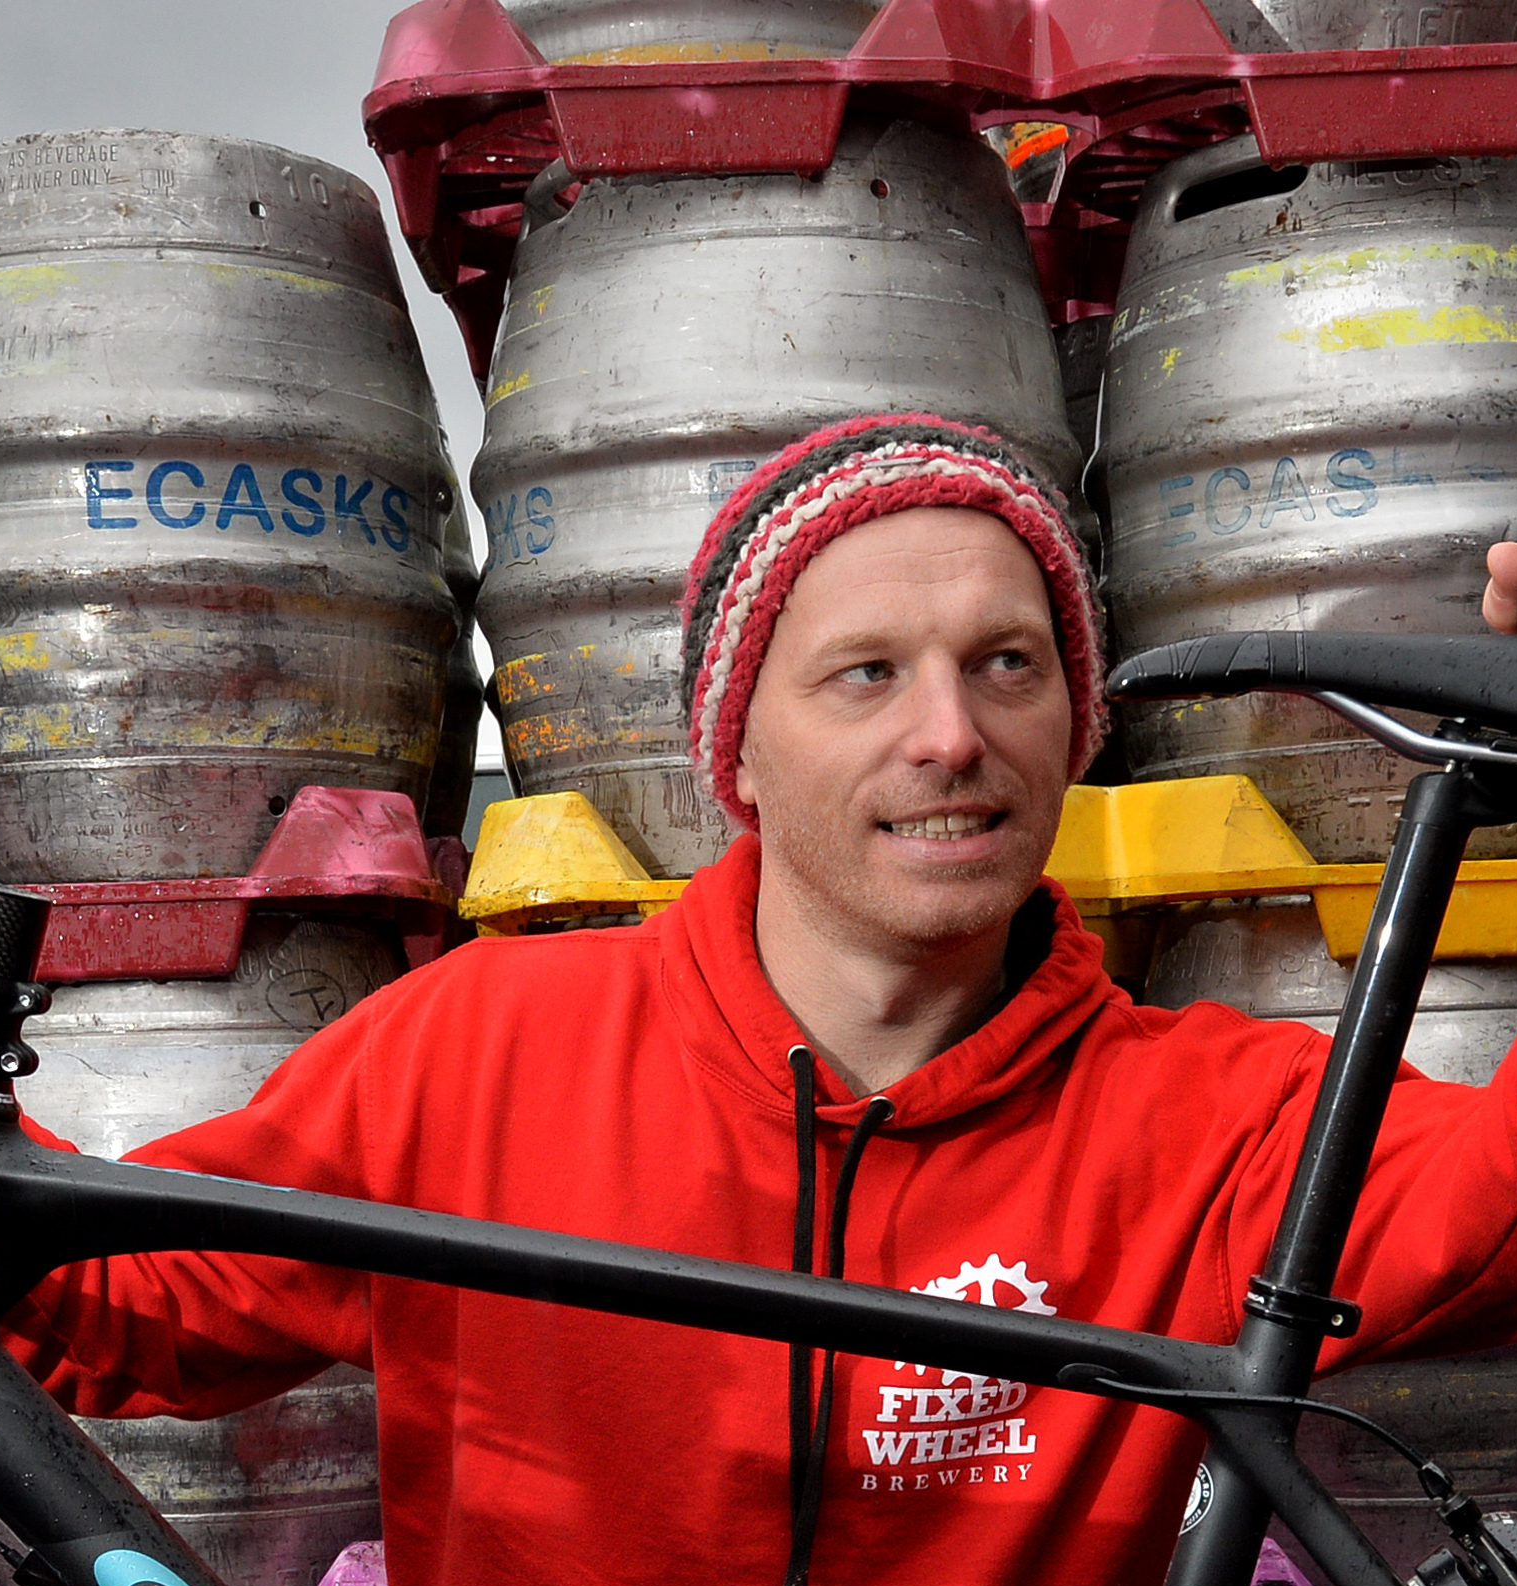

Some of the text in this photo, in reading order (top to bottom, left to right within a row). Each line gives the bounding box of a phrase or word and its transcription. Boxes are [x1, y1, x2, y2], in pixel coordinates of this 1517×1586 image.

[9, 152, 26, 171] AS
[34, 142, 119, 165] BEVERAGE
[71, 167, 112, 187] ONLY
[83, 460, 410, 554] ECASKS
[876, 1379, 1028, 1424] FIXED
[862, 1418, 1038, 1466] WHEEL
[861, 1463, 1034, 1492] BREWERY
